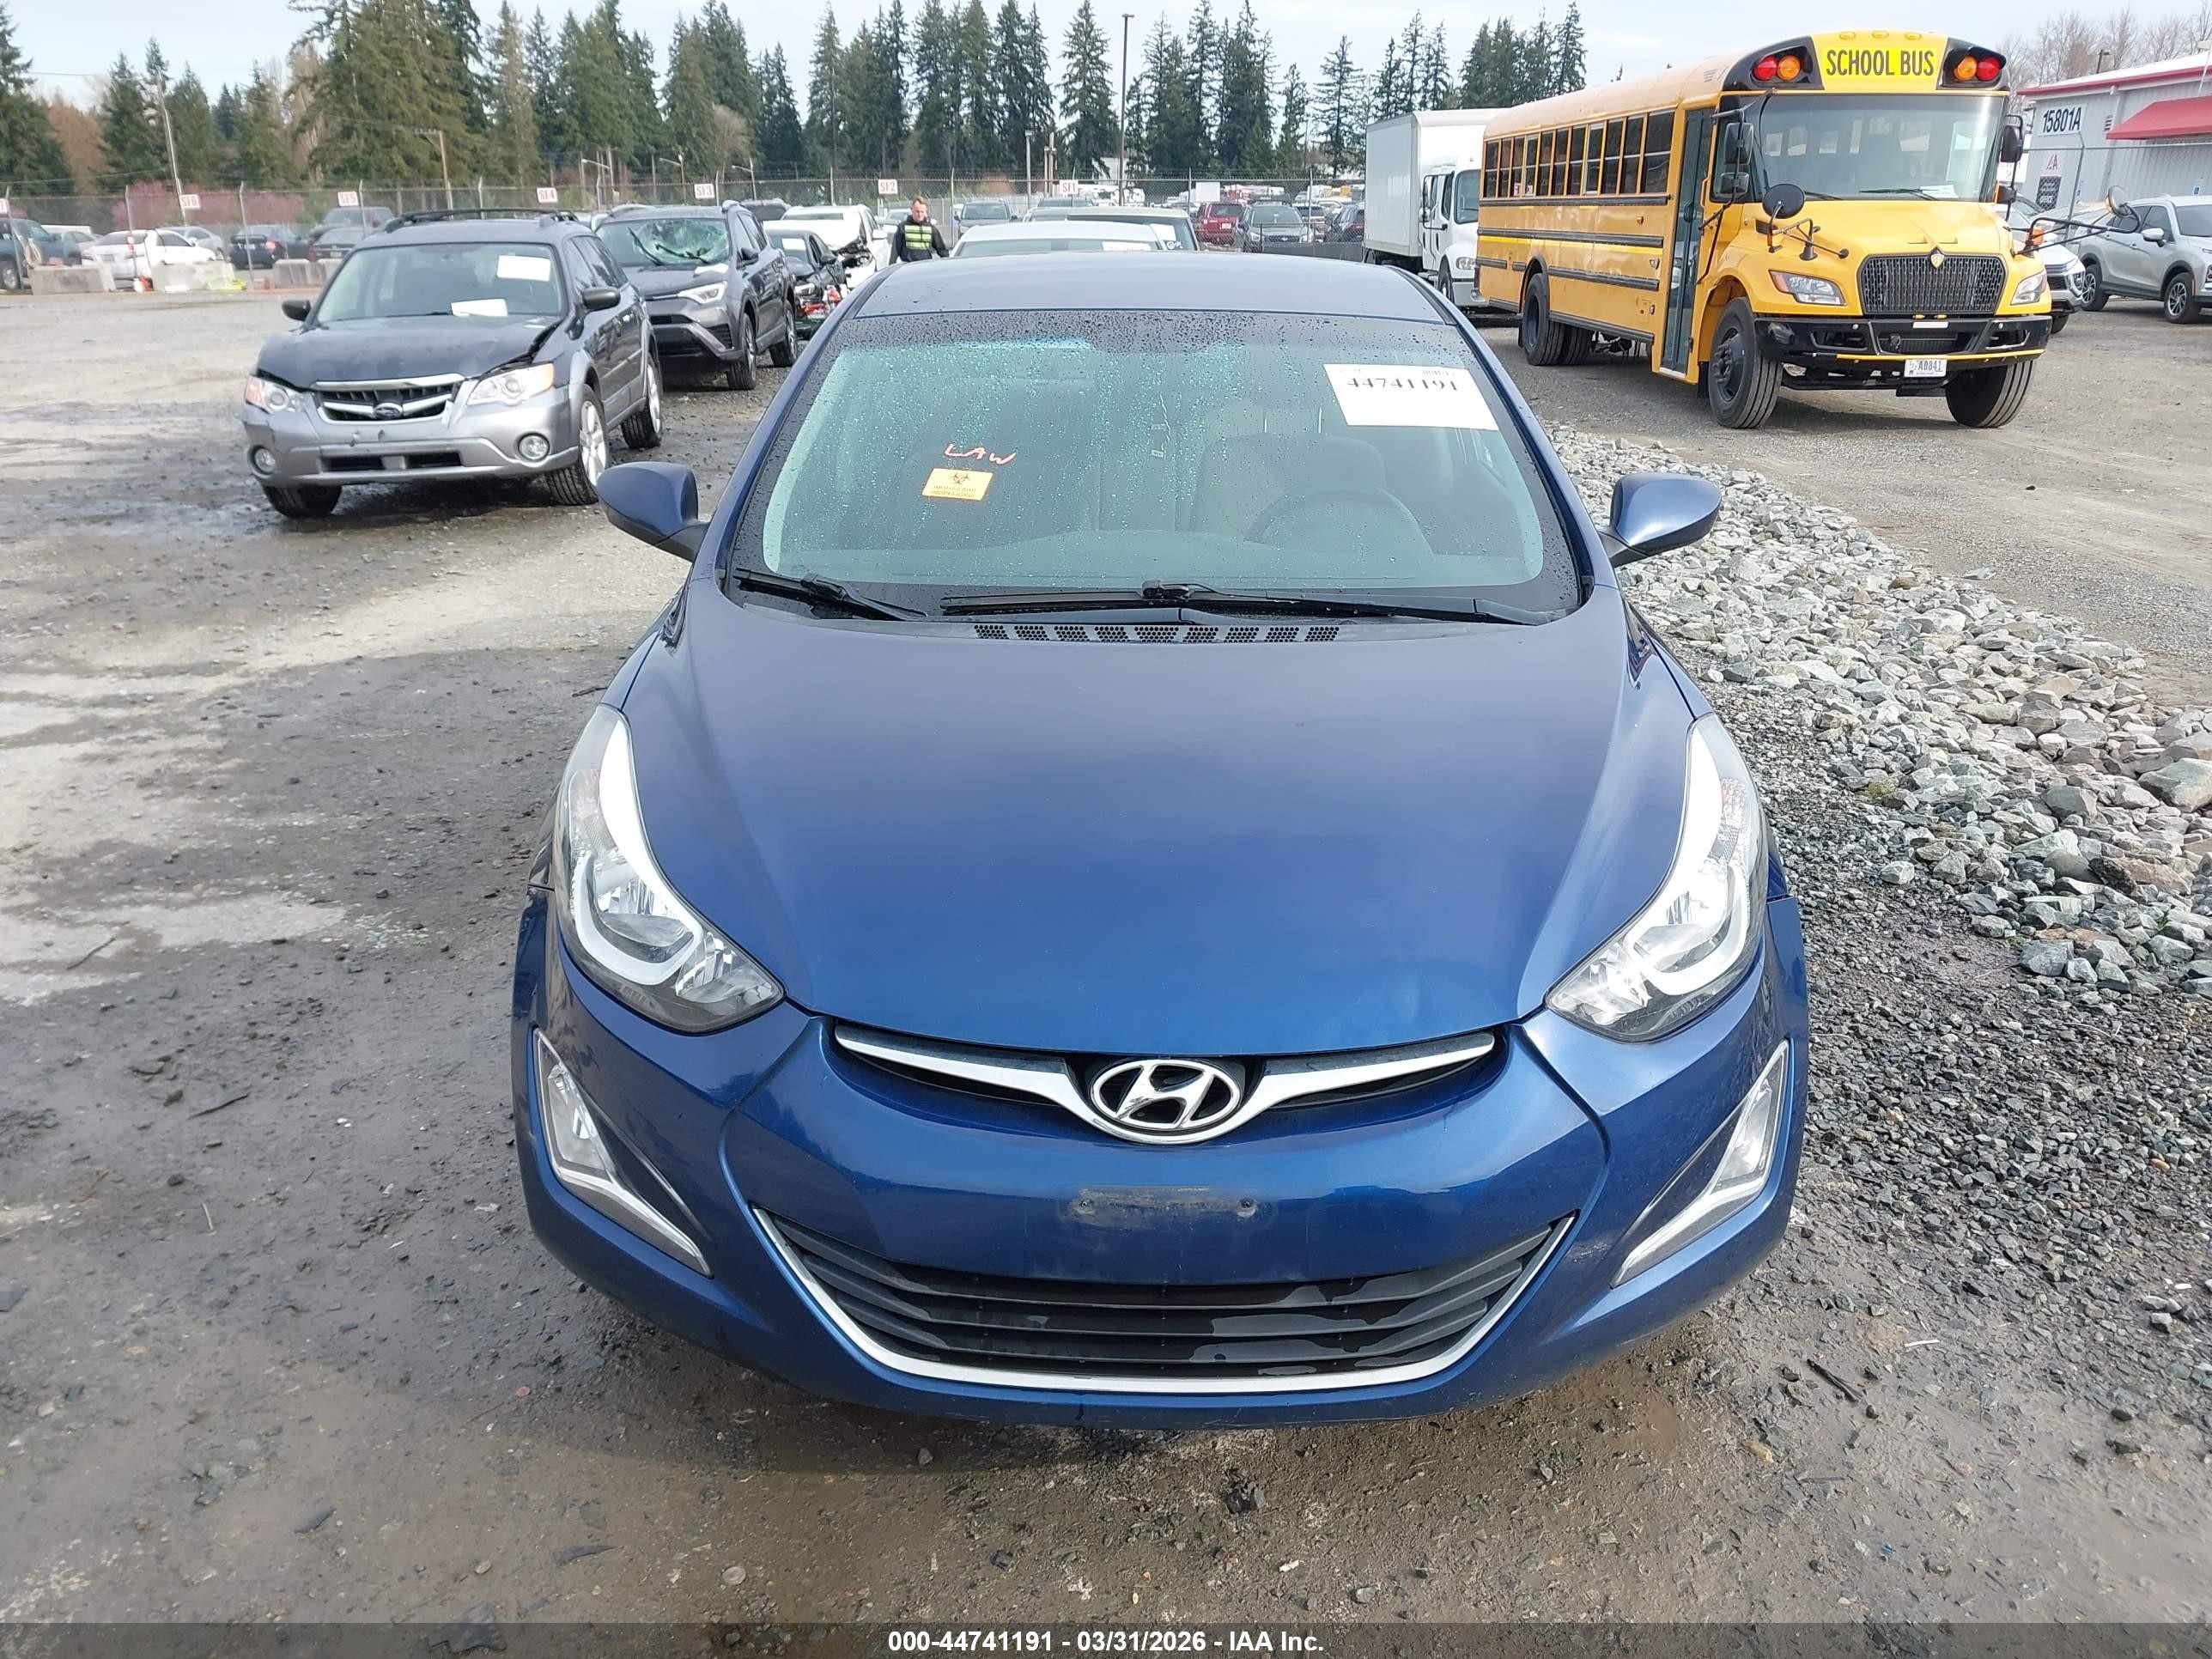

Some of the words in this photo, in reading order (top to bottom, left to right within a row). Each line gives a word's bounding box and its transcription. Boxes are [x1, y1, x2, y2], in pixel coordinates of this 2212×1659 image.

[1826, 49, 1895, 76] SCHOOL
[1900, 50, 1935, 76] BUS
[2043, 106, 2082, 133] 15801A
[696, 185, 713, 197] SF3
[879, 181, 896, 192] SF2
[1061, 181, 1075, 192] SF1
[1346, 377, 1458, 391] 44741191
[945, 443, 1017, 465] LAW
